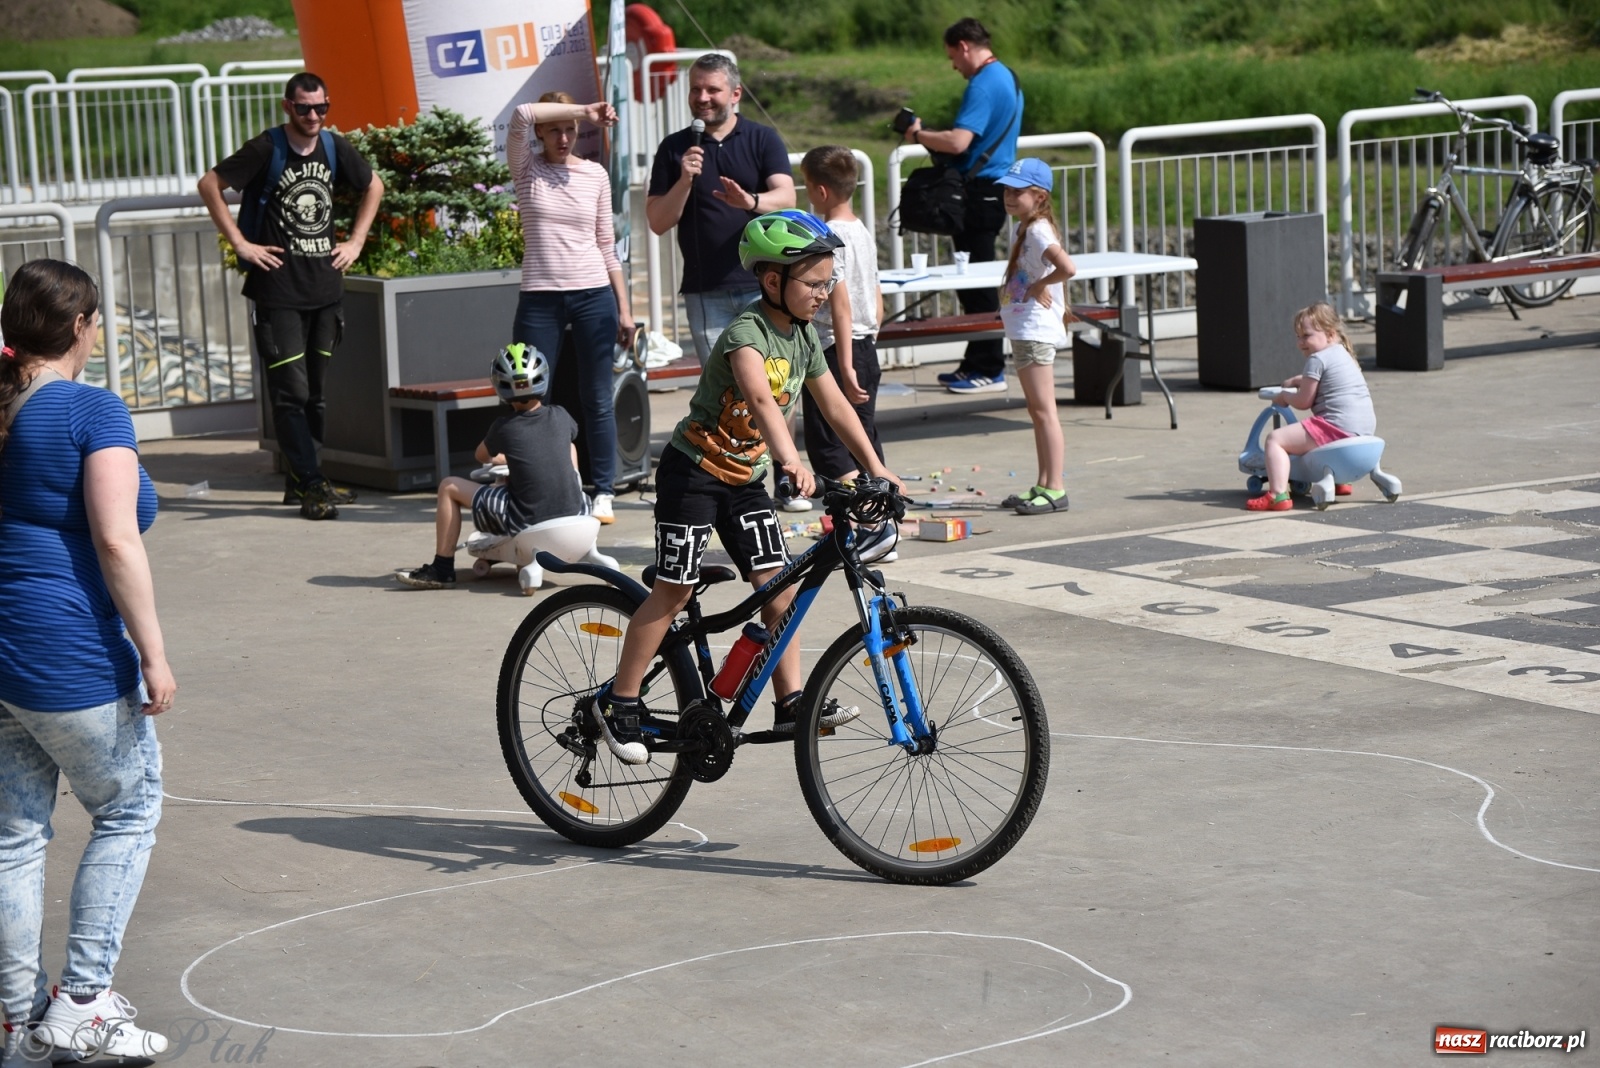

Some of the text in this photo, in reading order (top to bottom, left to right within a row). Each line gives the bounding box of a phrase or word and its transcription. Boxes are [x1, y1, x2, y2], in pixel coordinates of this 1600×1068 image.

[939, 566, 1014, 579] 8
[1026, 581, 1094, 597] 7
[1140, 601, 1220, 616] 6
[1245, 621, 1331, 638] 5
[1389, 642, 1463, 659] 4
[1507, 666, 1600, 684] 3
[880, 683, 898, 726] CAPA
